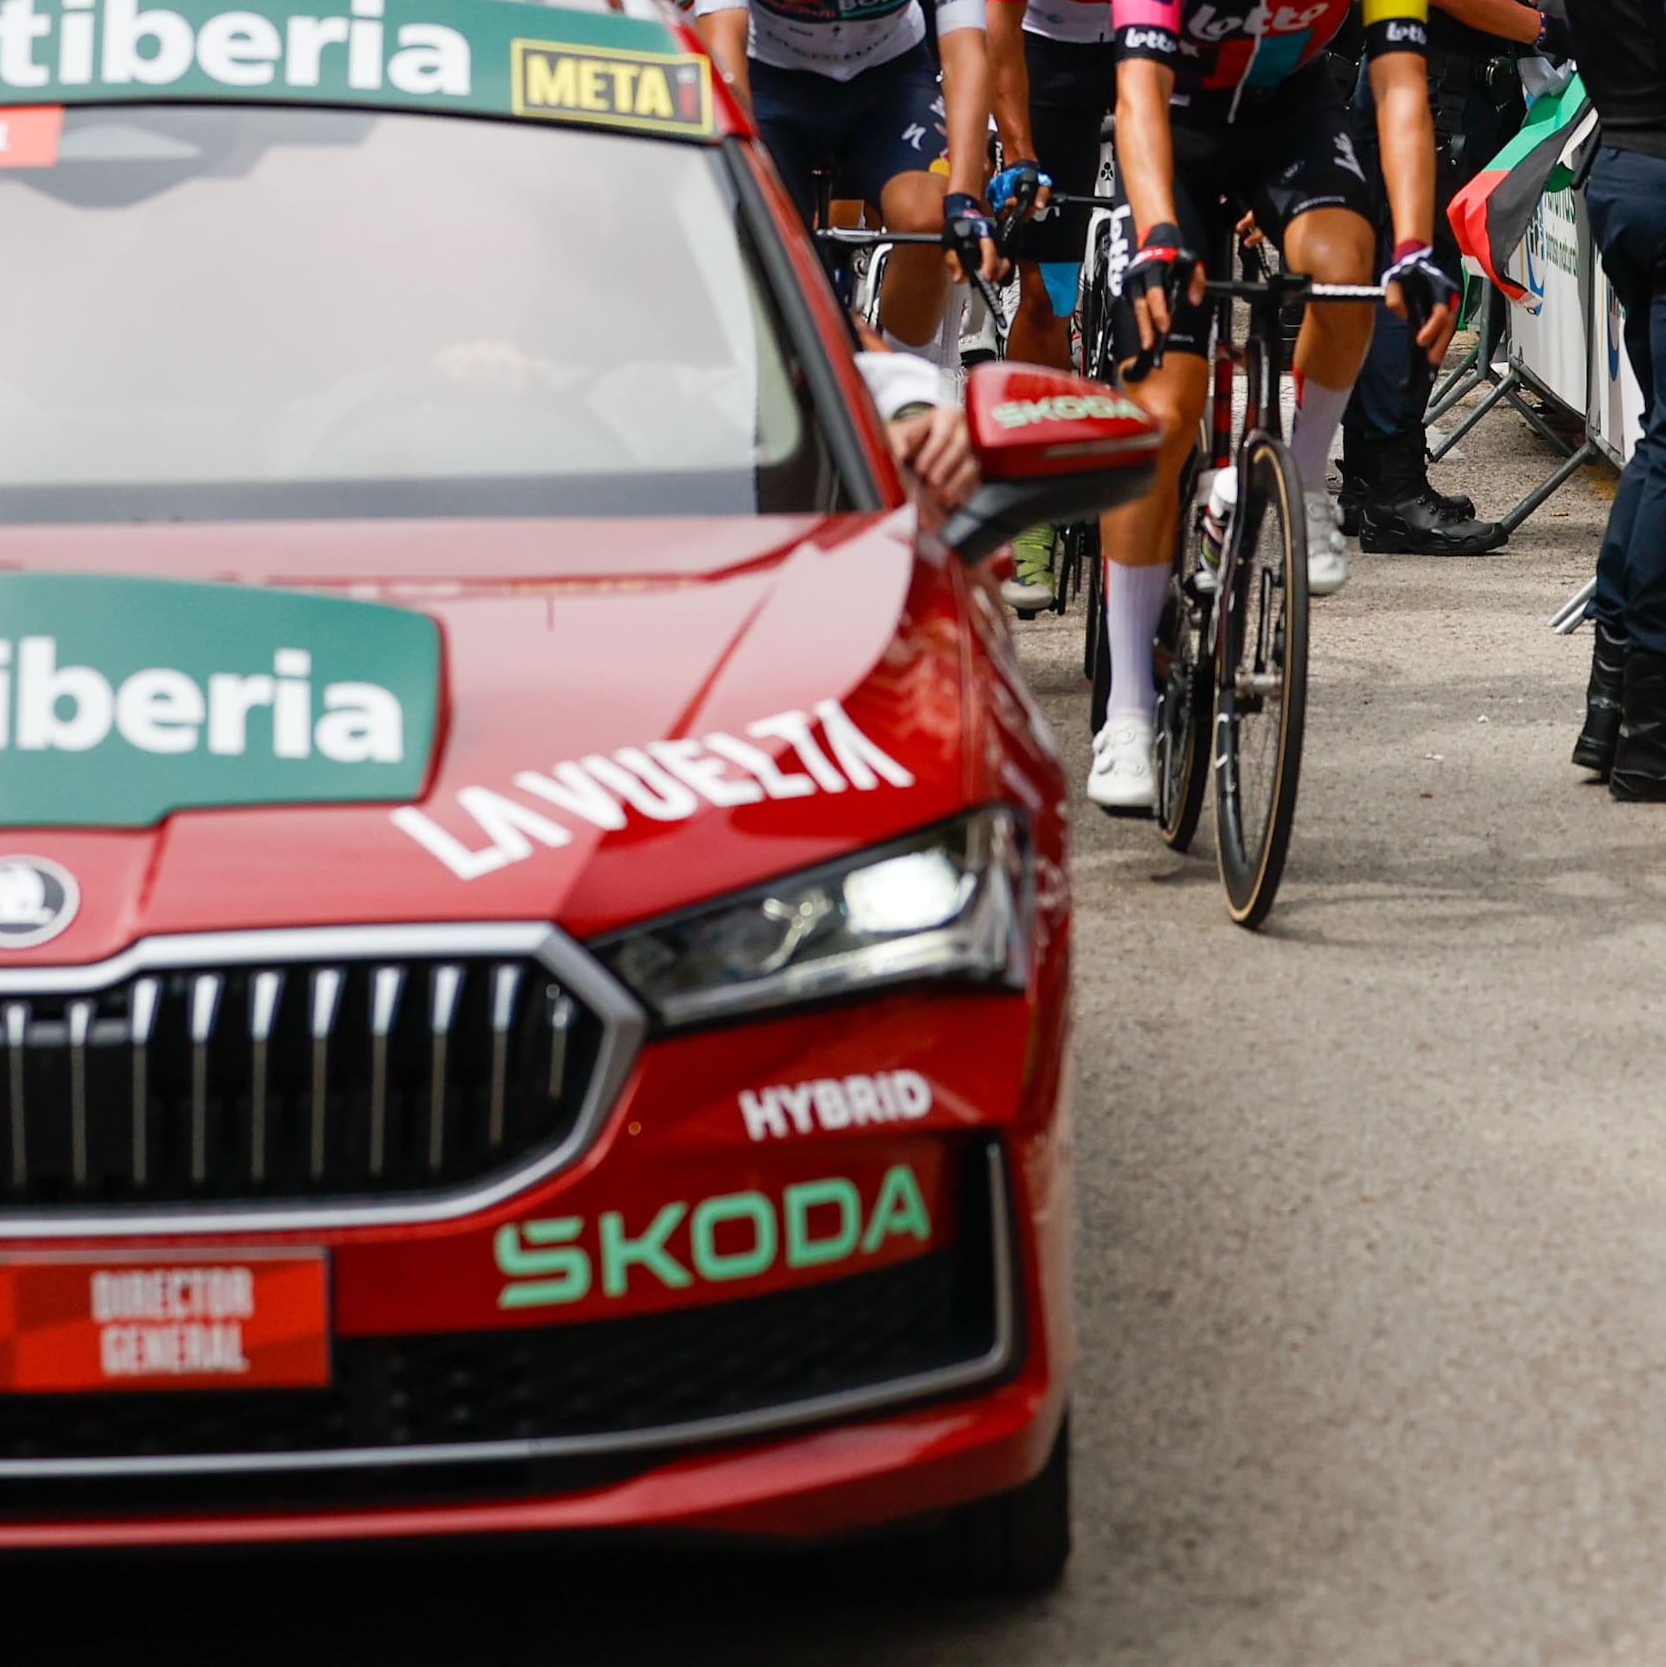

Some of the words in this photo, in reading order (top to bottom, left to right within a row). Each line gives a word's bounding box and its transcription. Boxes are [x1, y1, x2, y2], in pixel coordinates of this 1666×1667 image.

[526, 53, 675, 118] META
[389, 785, 534, 880] LA
[514, 698, 915, 852] VUELTA
[739, 1069, 933, 1140] HYBRID
[100, 1325, 250, 1377] GENERAL
